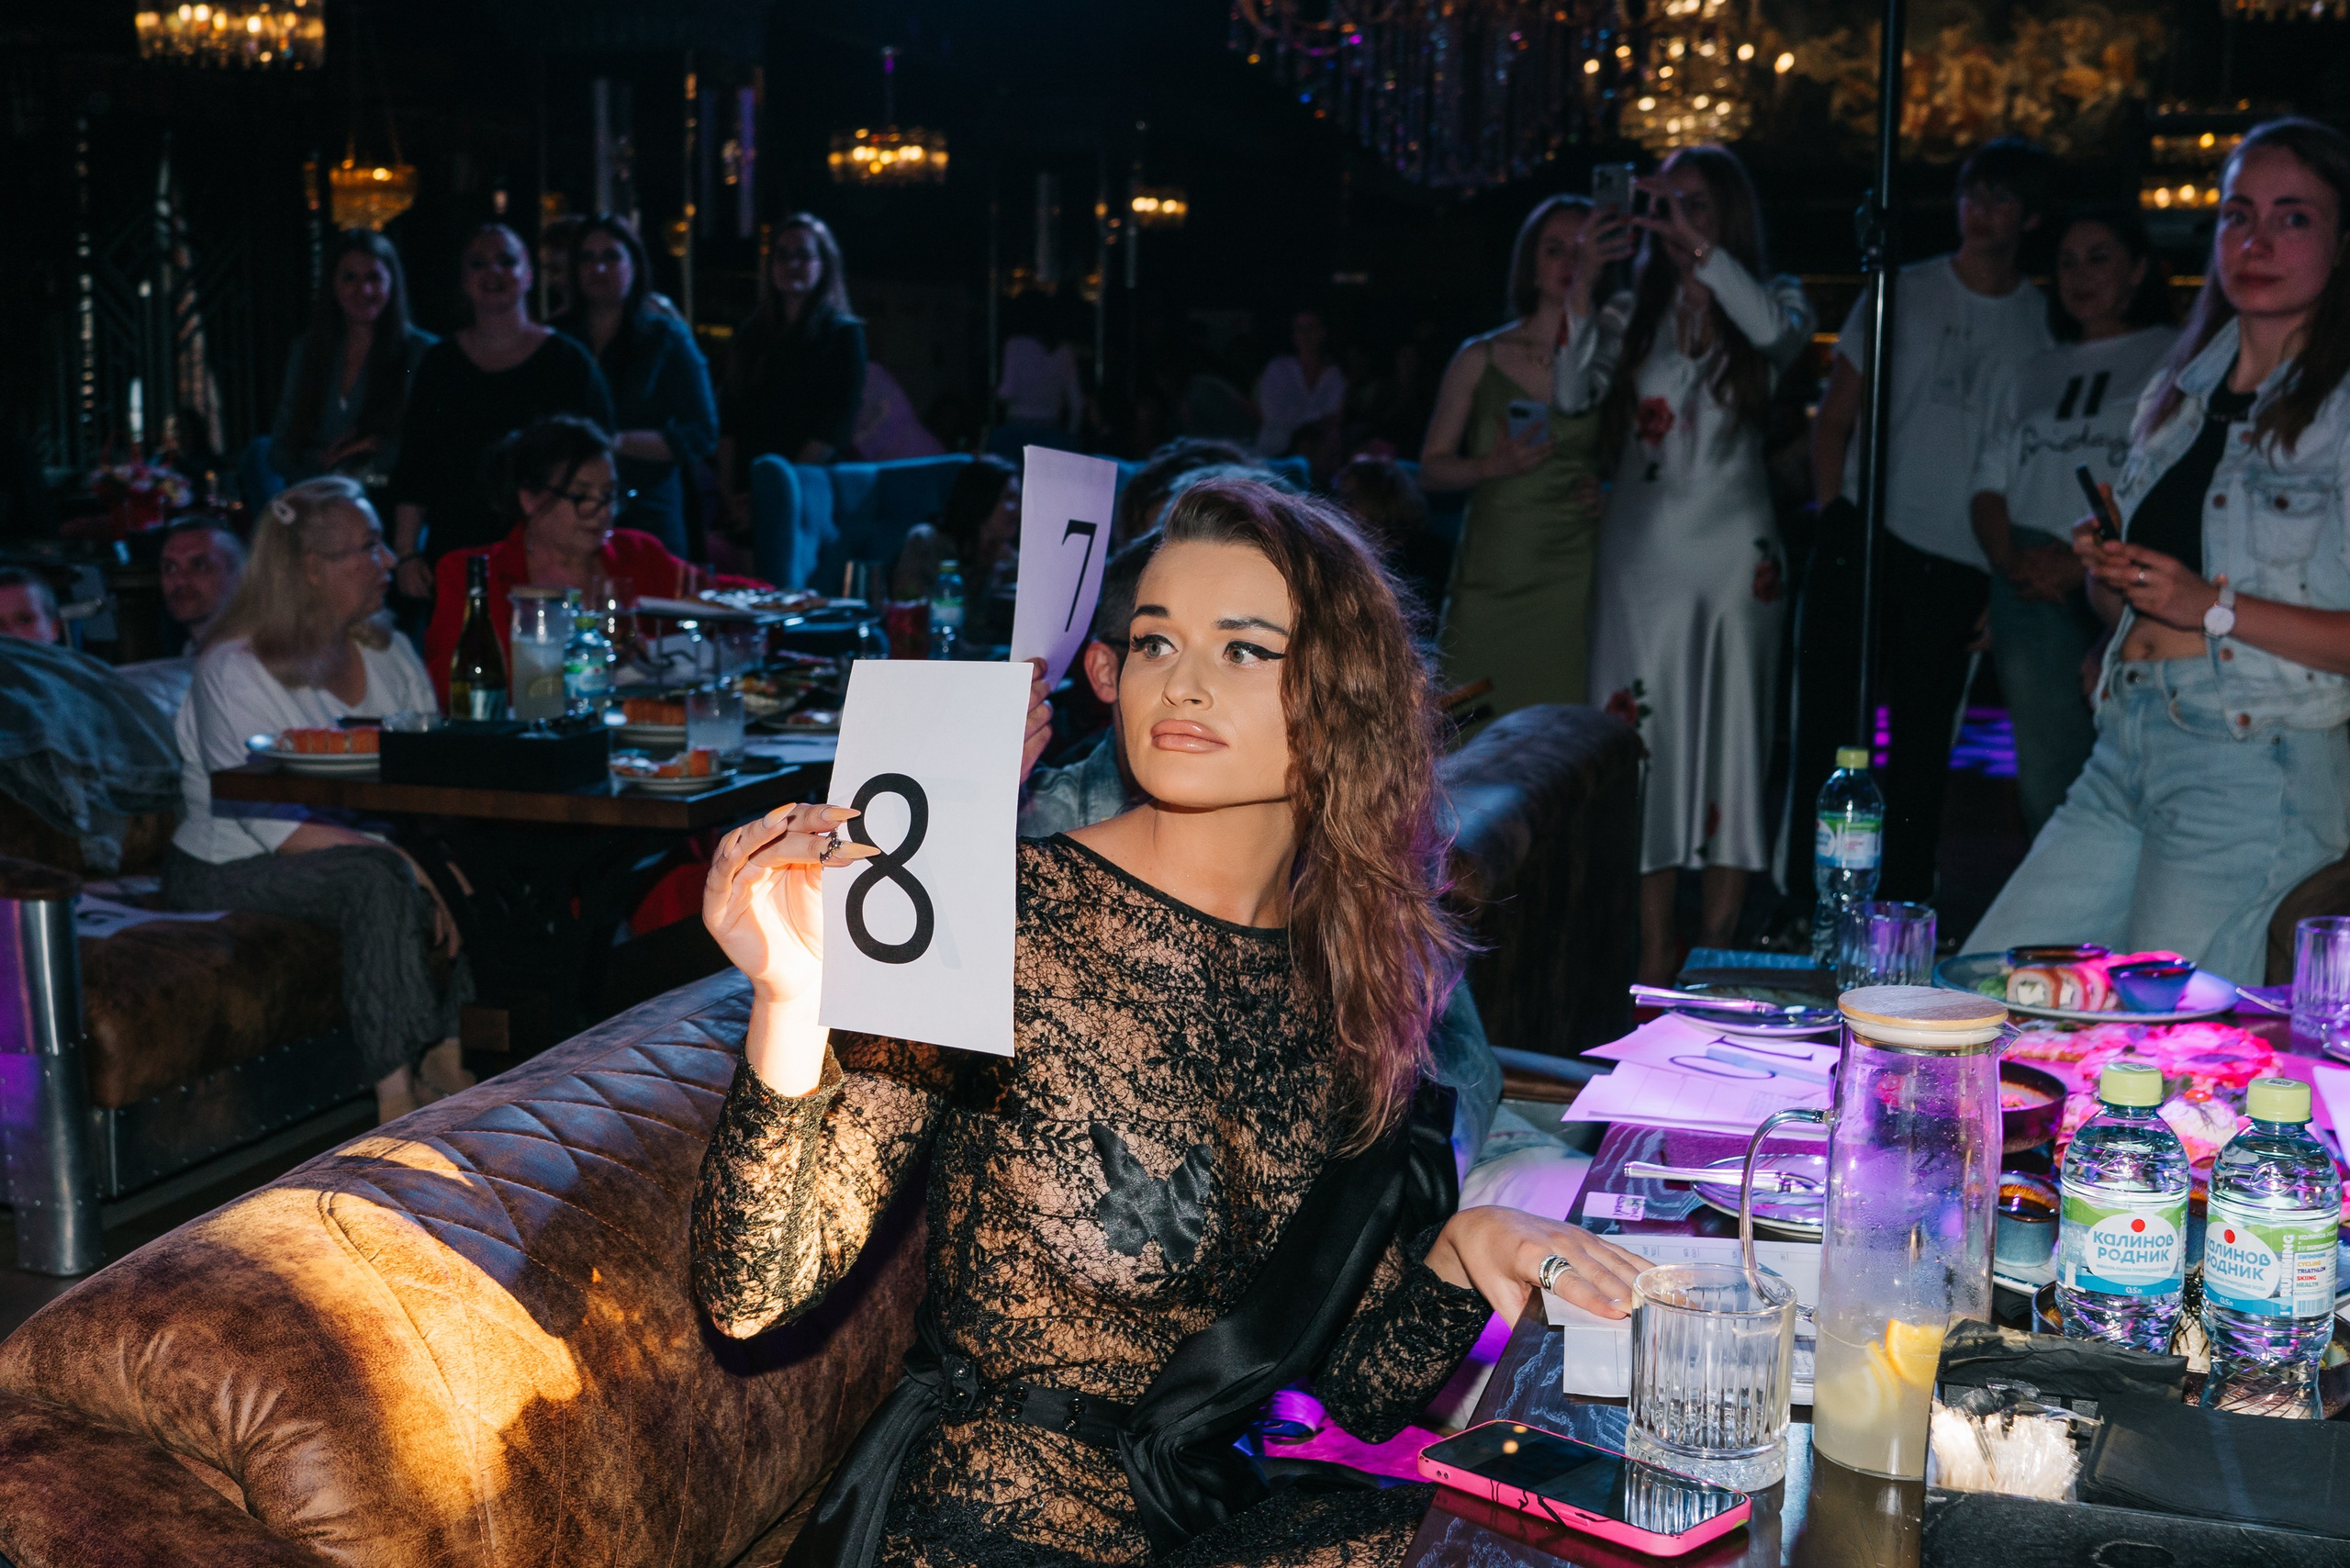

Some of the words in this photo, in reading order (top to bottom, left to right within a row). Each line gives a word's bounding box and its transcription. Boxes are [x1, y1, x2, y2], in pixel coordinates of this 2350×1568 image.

[1061, 519, 1097, 633] 7
[845, 772, 935, 965] 8
[2098, 1247, 2170, 1264] РОДНИК
